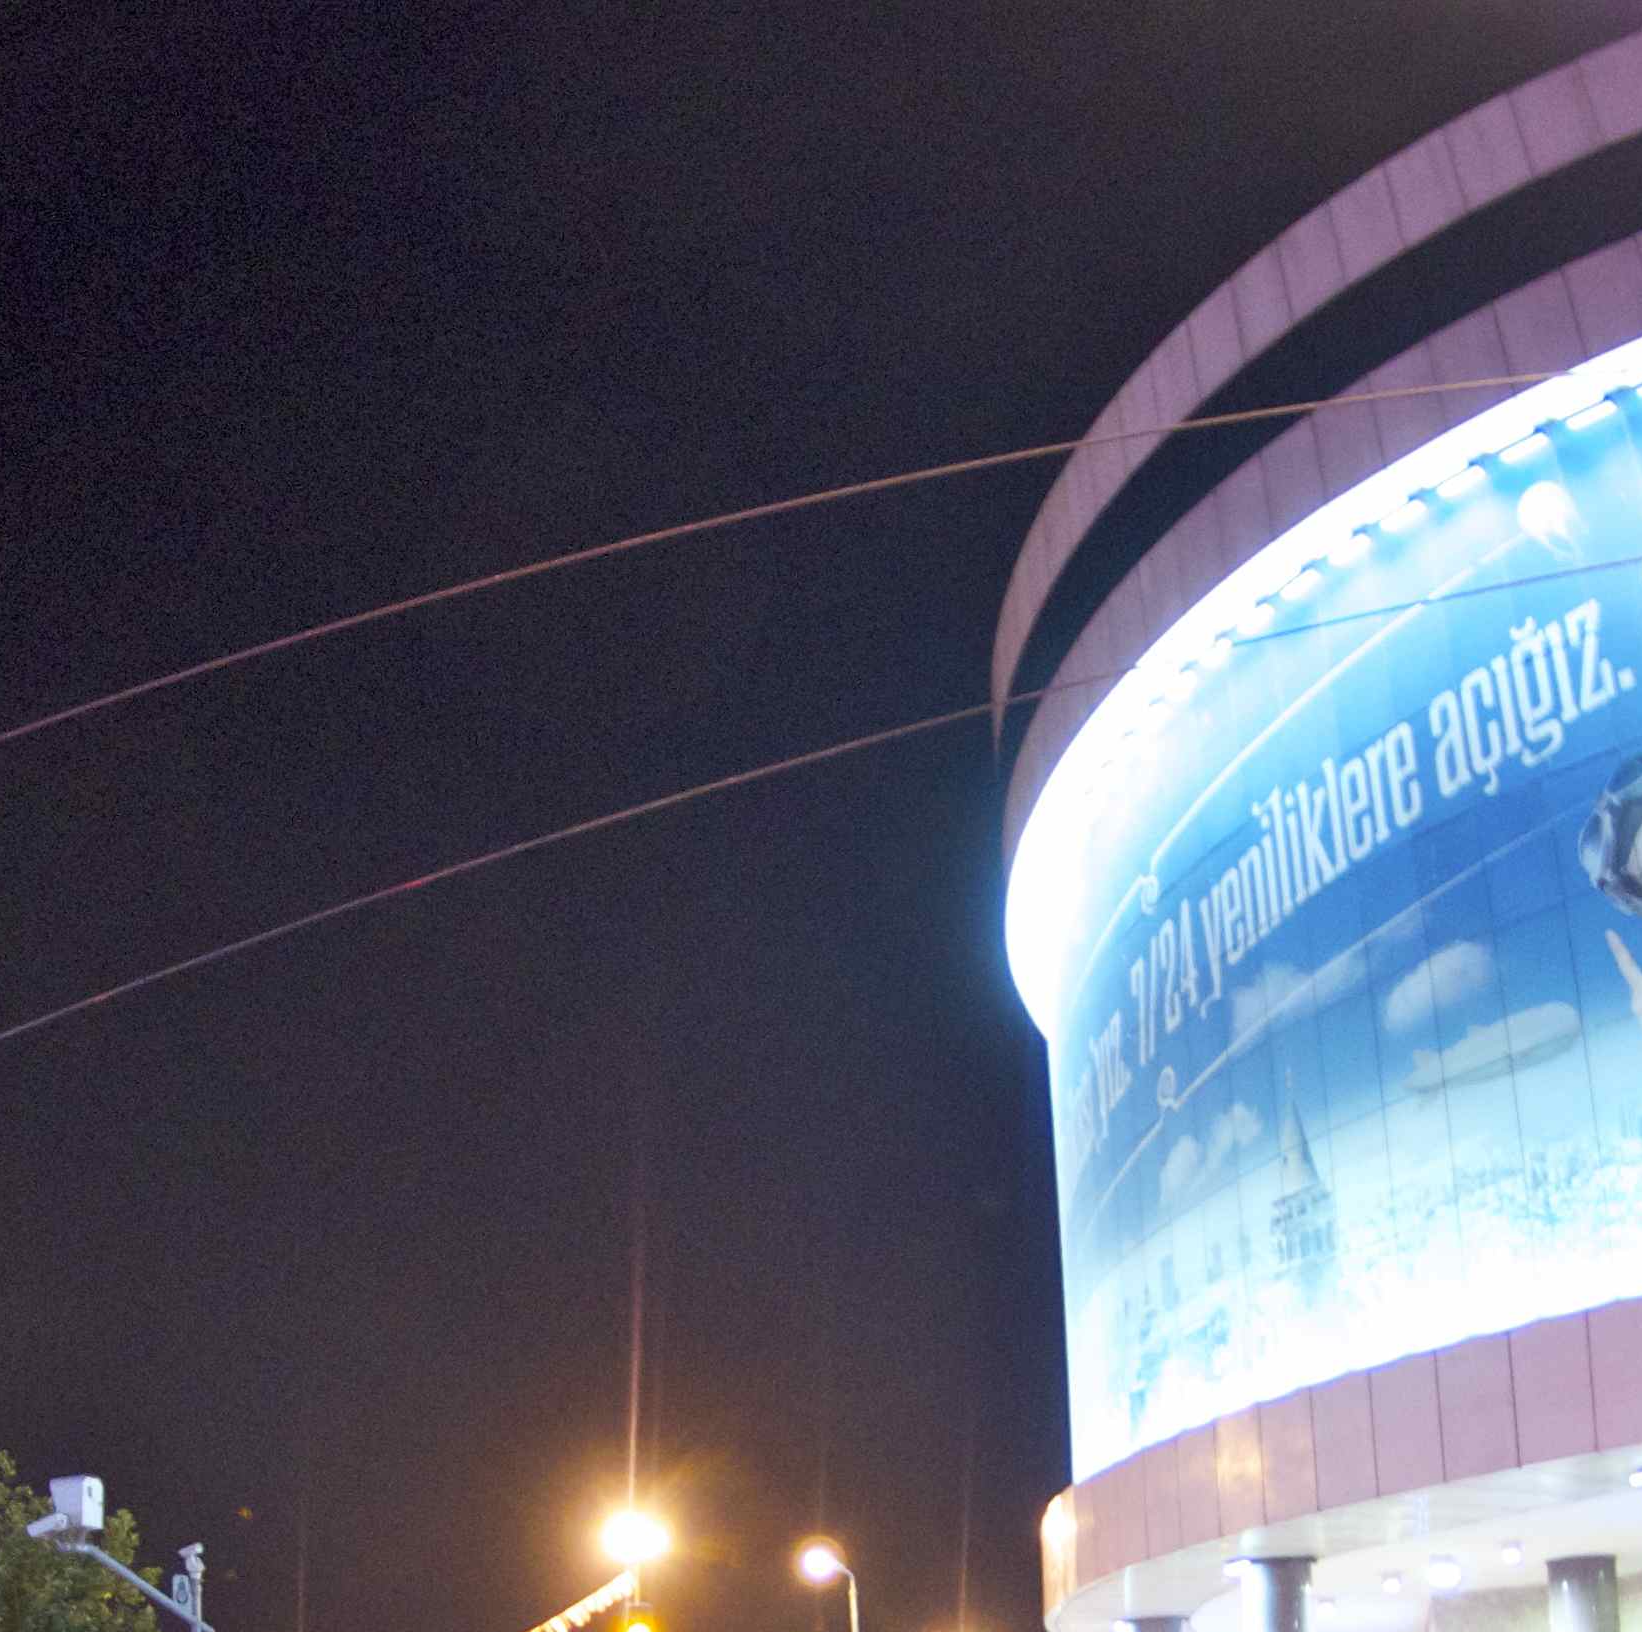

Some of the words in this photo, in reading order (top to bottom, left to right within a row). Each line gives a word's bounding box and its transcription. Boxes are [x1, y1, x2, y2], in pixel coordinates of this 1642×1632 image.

[1131, 908, 1199, 1067] 7/24
[1199, 721, 1424, 1018] yeniliklere
[1428, 597, 1636, 798] açığız.
